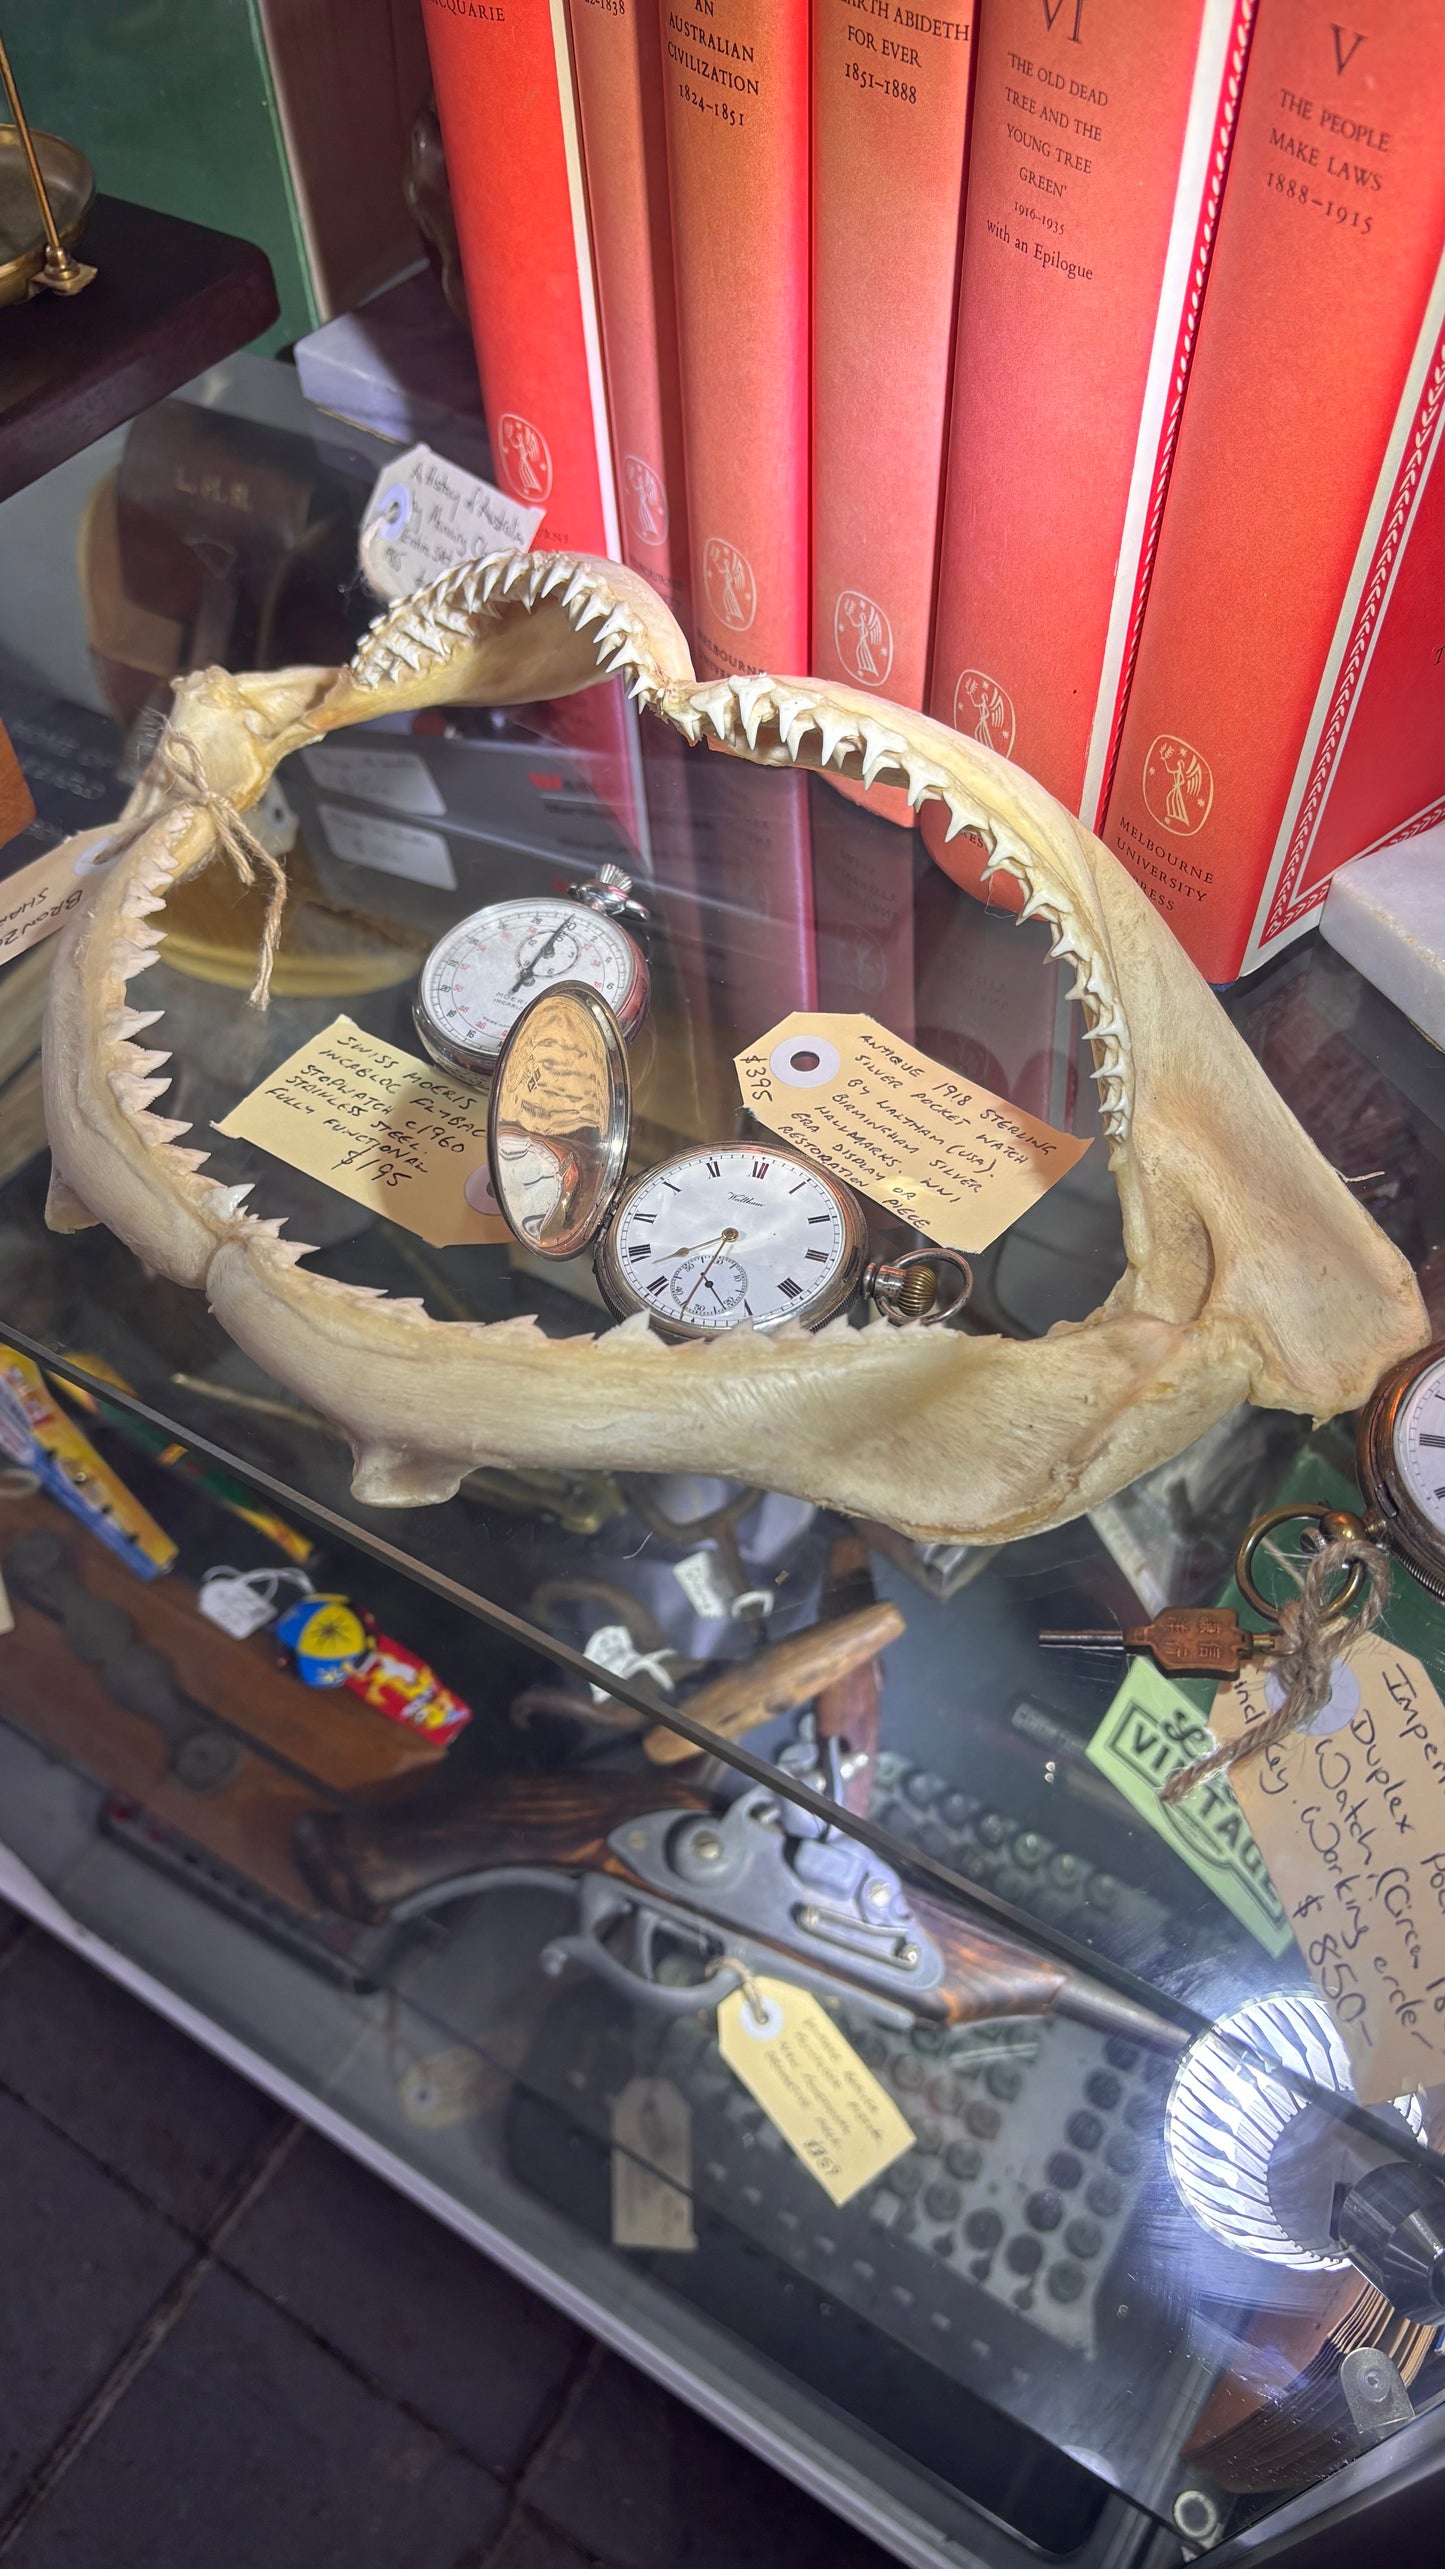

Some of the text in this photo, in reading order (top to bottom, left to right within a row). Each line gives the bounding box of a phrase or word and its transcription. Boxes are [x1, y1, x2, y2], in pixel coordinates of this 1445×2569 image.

[430, 0, 505, 22] CQUARIE
[695, 0, 714, 17] AN
[894, 7, 970, 42] ABIDETH
[1040, 0, 1083, 45] VI
[669, 12, 755, 63] AUSTRALIAN
[847, 25, 922, 68] FOR EVER
[1329, 22, 1367, 77] V
[667, 42, 760, 96] CIVILIZATION
[1037, 67, 1065, 91] OLD
[1069, 80, 1109, 107] DEAD
[1005, 86, 1102, 142] TREE AND THE
[1279, 88, 1392, 153] THE PEOPLE
[1006, 123, 1092, 175] YOUNG TREE
[1269, 127, 1382, 193] MAKE LAWS
[986, 218, 1094, 281] with an Epilogue
[1116, 836, 1208, 902] UNIVERSITY
[1119, 816, 1214, 884] MELBOURNE
[0, 889, 84, 947] BRONZ
[493, 998, 524, 1011] INCABLO
[495, 991, 528, 1005] MOERI
[466, 1029, 477, 1039] 16
[285, 1075, 368, 1118] STAINLESS
[300, 1063, 395, 1116] STOPWATCH
[318, 1049, 487, 1139] INCABLOC FLYBAC
[337, 1036, 478, 1110] SWISS MOERIS
[740, 1054, 774, 1103] $395
[859, 1034, 1057, 1156] ANTIQUE 1918 STERLING
[265, 1086, 428, 1174] FULLY FUNCTIONAL
[847, 1078, 870, 1096] BY
[876, 1099, 945, 1146] WALTHAM
[855, 1054, 1029, 1165] SILVER POCKET WATCH
[330, 1148, 413, 1188] $195
[790, 1112, 917, 1201] ERA DISPLAY OR
[831, 1093, 984, 1194] BIRMINGHAM SILVER
[727, 1190, 765, 1208] Waltham
[777, 1125, 931, 1230] RESTORATION PIECE
[807, 1213, 831, 1225] II
[804, 1248, 830, 1264] III
[1350, 1708, 1415, 1835] Duplex
[1300, 1806, 1371, 1950] Working
